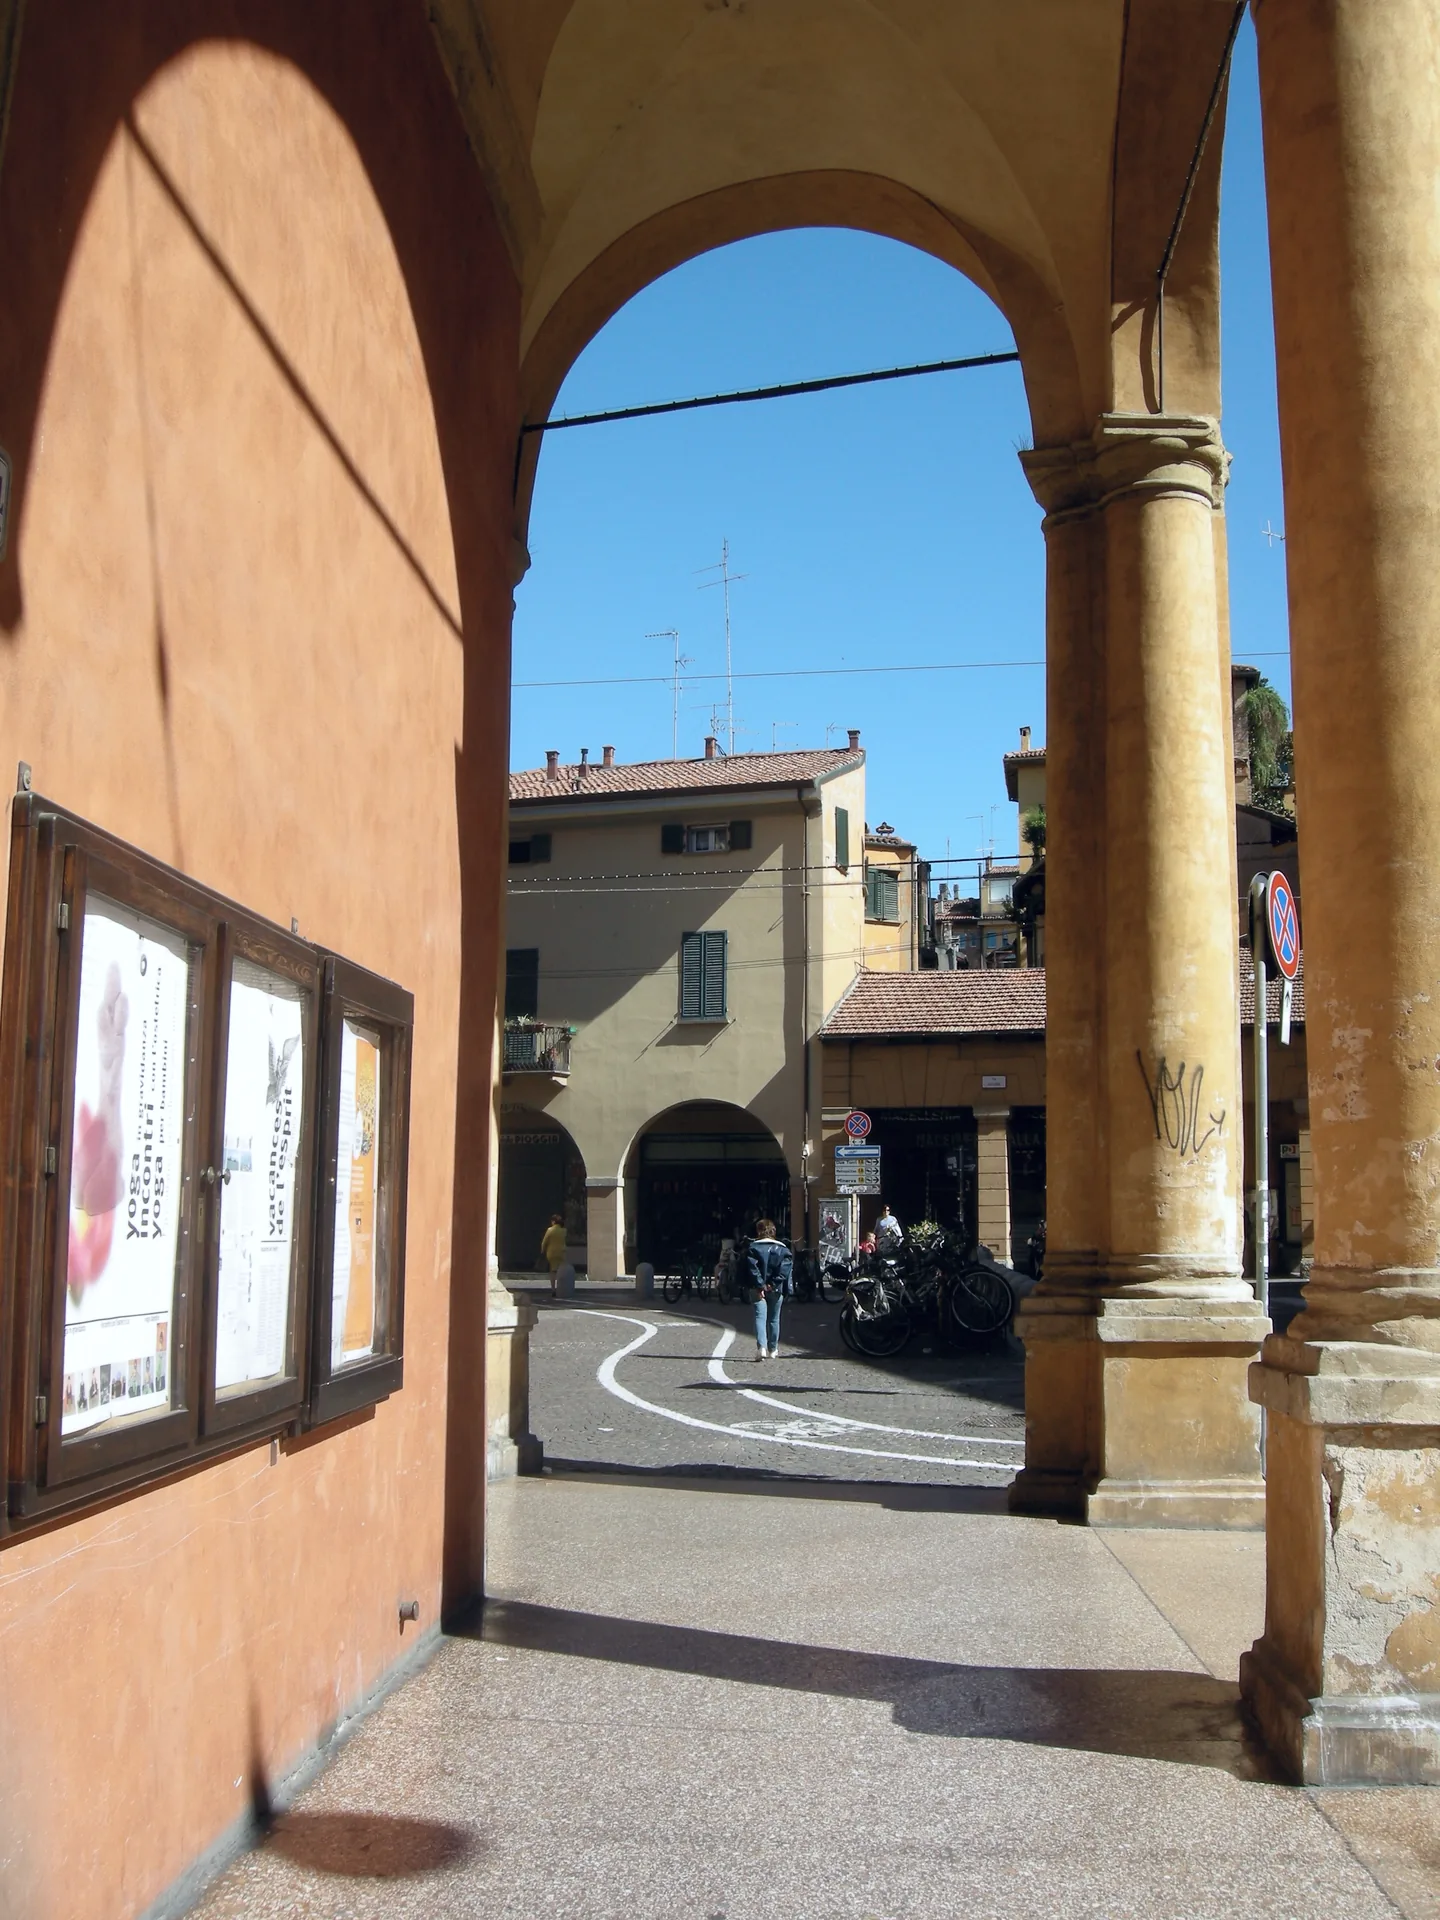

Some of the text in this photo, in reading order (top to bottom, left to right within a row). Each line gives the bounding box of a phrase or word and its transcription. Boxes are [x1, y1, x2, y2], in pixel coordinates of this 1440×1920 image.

[125, 1153, 140, 1240] yoga
[138, 1019, 147, 1119] gravidanza
[138, 1102, 154, 1239] incontri
[151, 1039, 168, 1240] yoga per bambini
[267, 1099, 283, 1237] vacances
[276, 1085, 293, 1190] l'esprit
[276, 1199, 284, 1236] de
